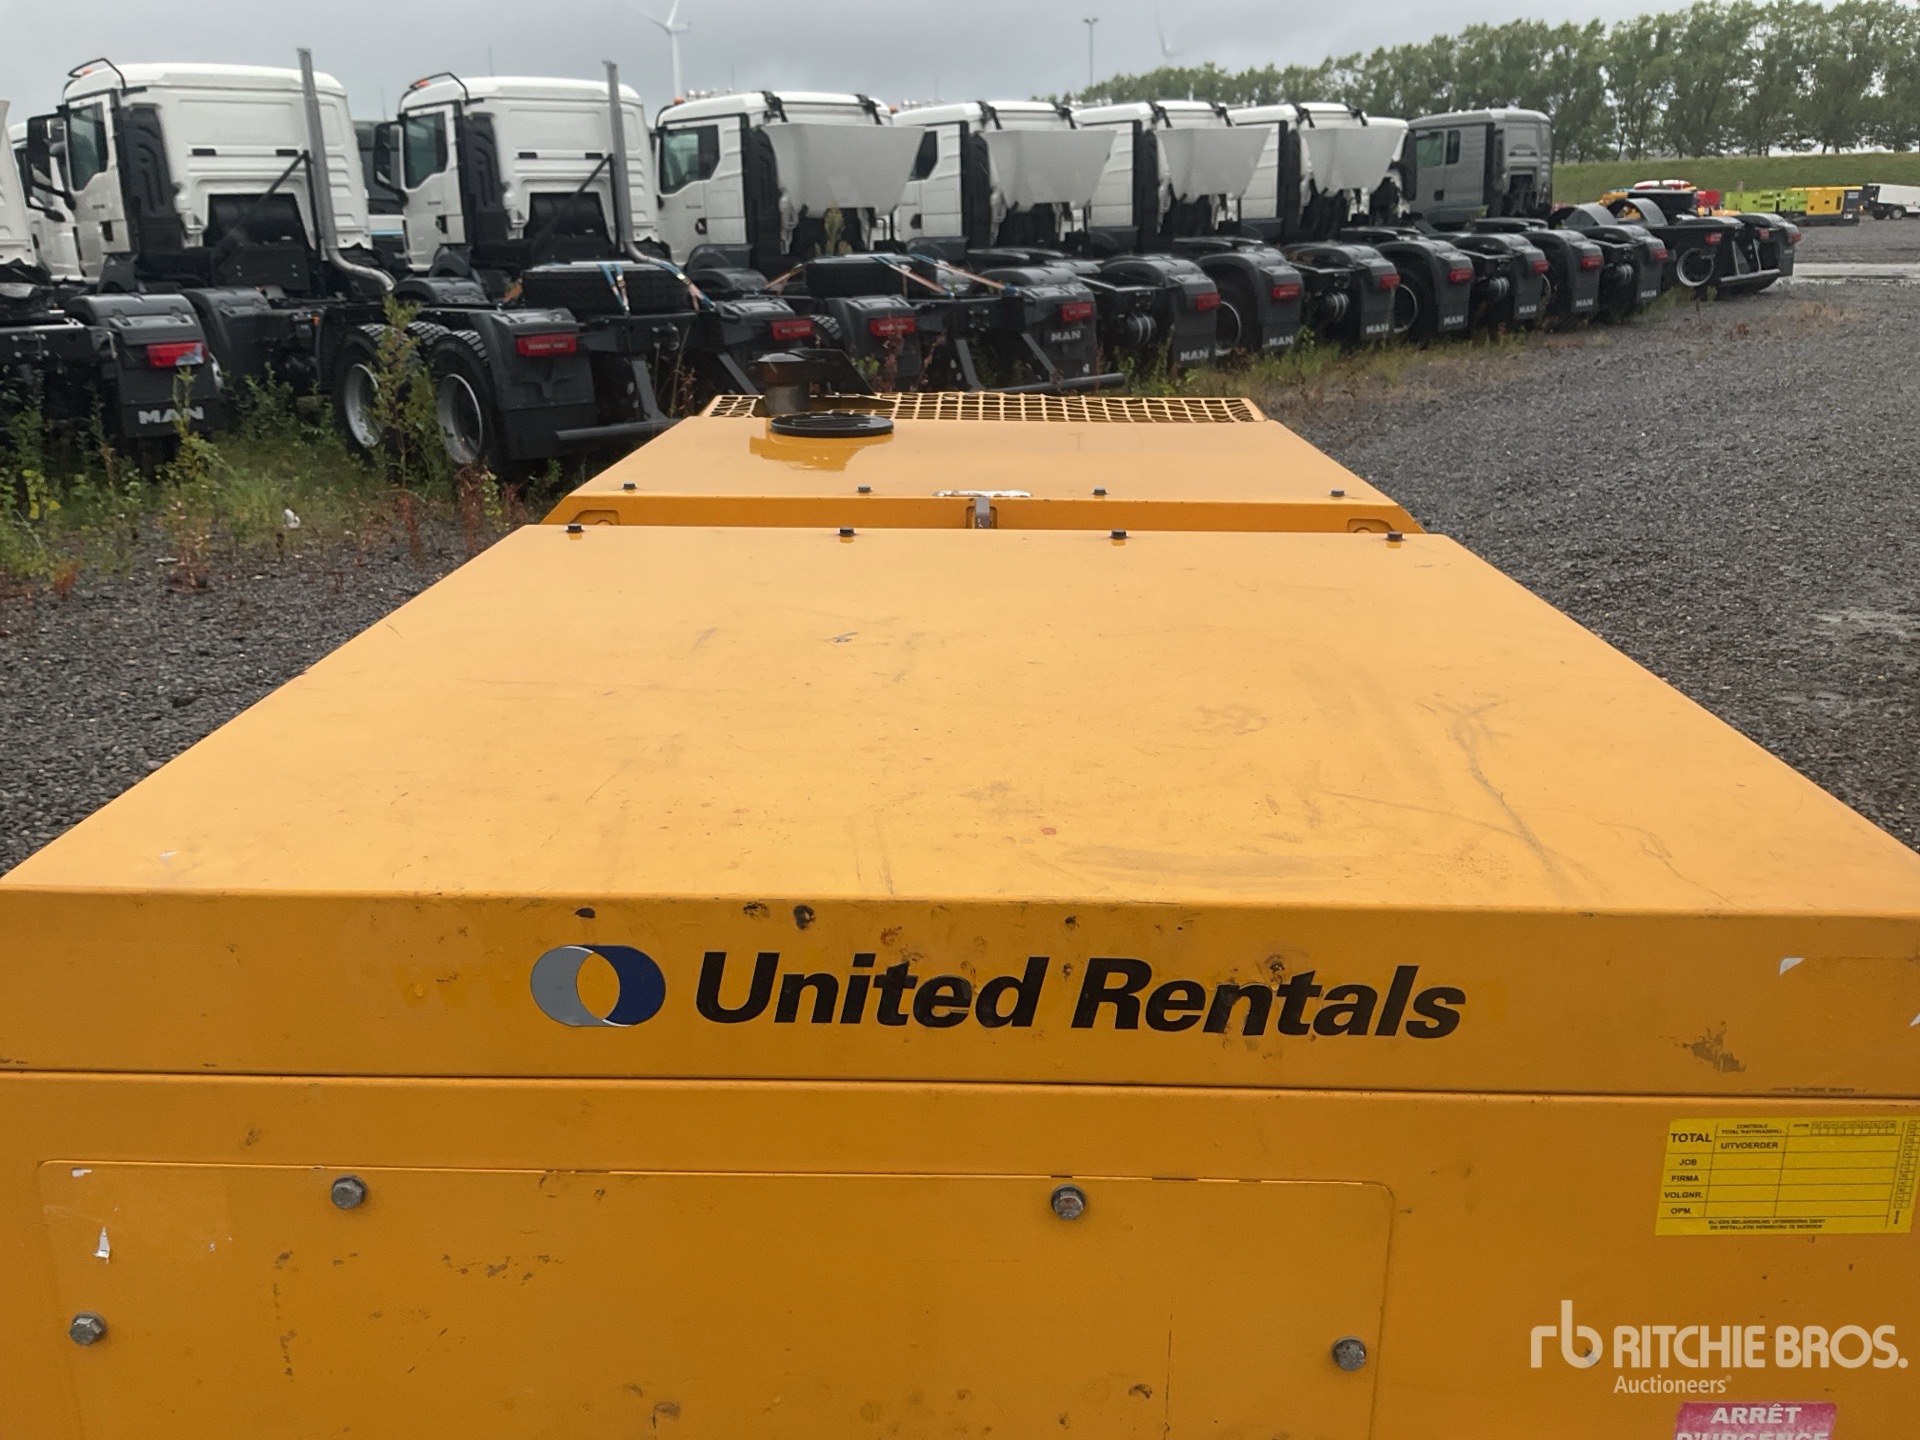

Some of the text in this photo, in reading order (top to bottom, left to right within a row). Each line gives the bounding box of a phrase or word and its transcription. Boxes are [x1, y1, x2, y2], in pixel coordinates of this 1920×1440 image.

[1051, 330, 1081, 342] MAN
[1269, 336, 1294, 346] MAN
[1181, 349, 1209, 361] MAN
[138, 406, 204, 424] MAN
[695, 951, 1467, 1040] United Rentals
[1670, 1132, 1713, 1143] TOTAL
[1664, 1191, 1703, 1199] VOLGNR.
[1670, 1207, 1692, 1215] OPM.
[1710, 1403, 1802, 1424] ARRÊT
